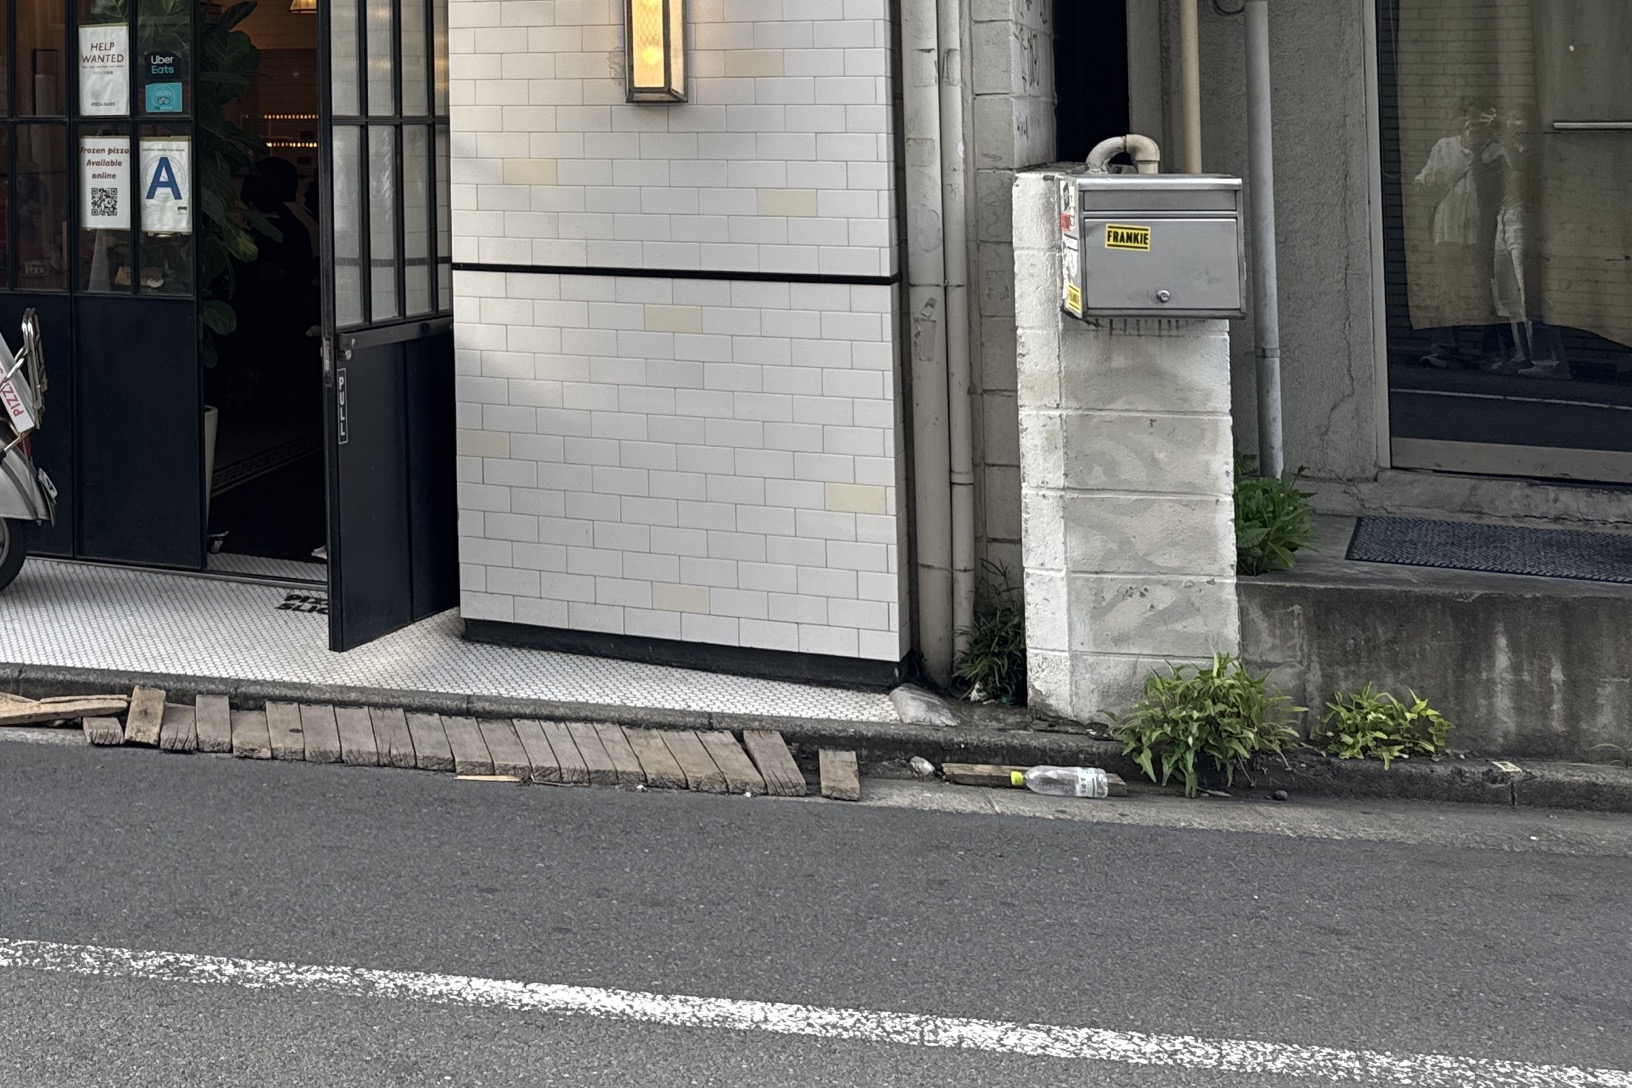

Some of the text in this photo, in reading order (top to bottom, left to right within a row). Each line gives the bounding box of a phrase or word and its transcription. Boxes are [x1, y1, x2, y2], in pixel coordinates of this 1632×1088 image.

[91, 42, 115, 52] HELP
[82, 54, 125, 64] WANTED
[151, 55, 174, 65] Uber
[151, 65, 175, 75] Eats
[108, 147, 130, 156] pizza
[86, 159, 123, 167] Available
[92, 172, 117, 180] online
[146, 157, 183, 200] A
[1107, 230, 1149, 246] FRANKIE
